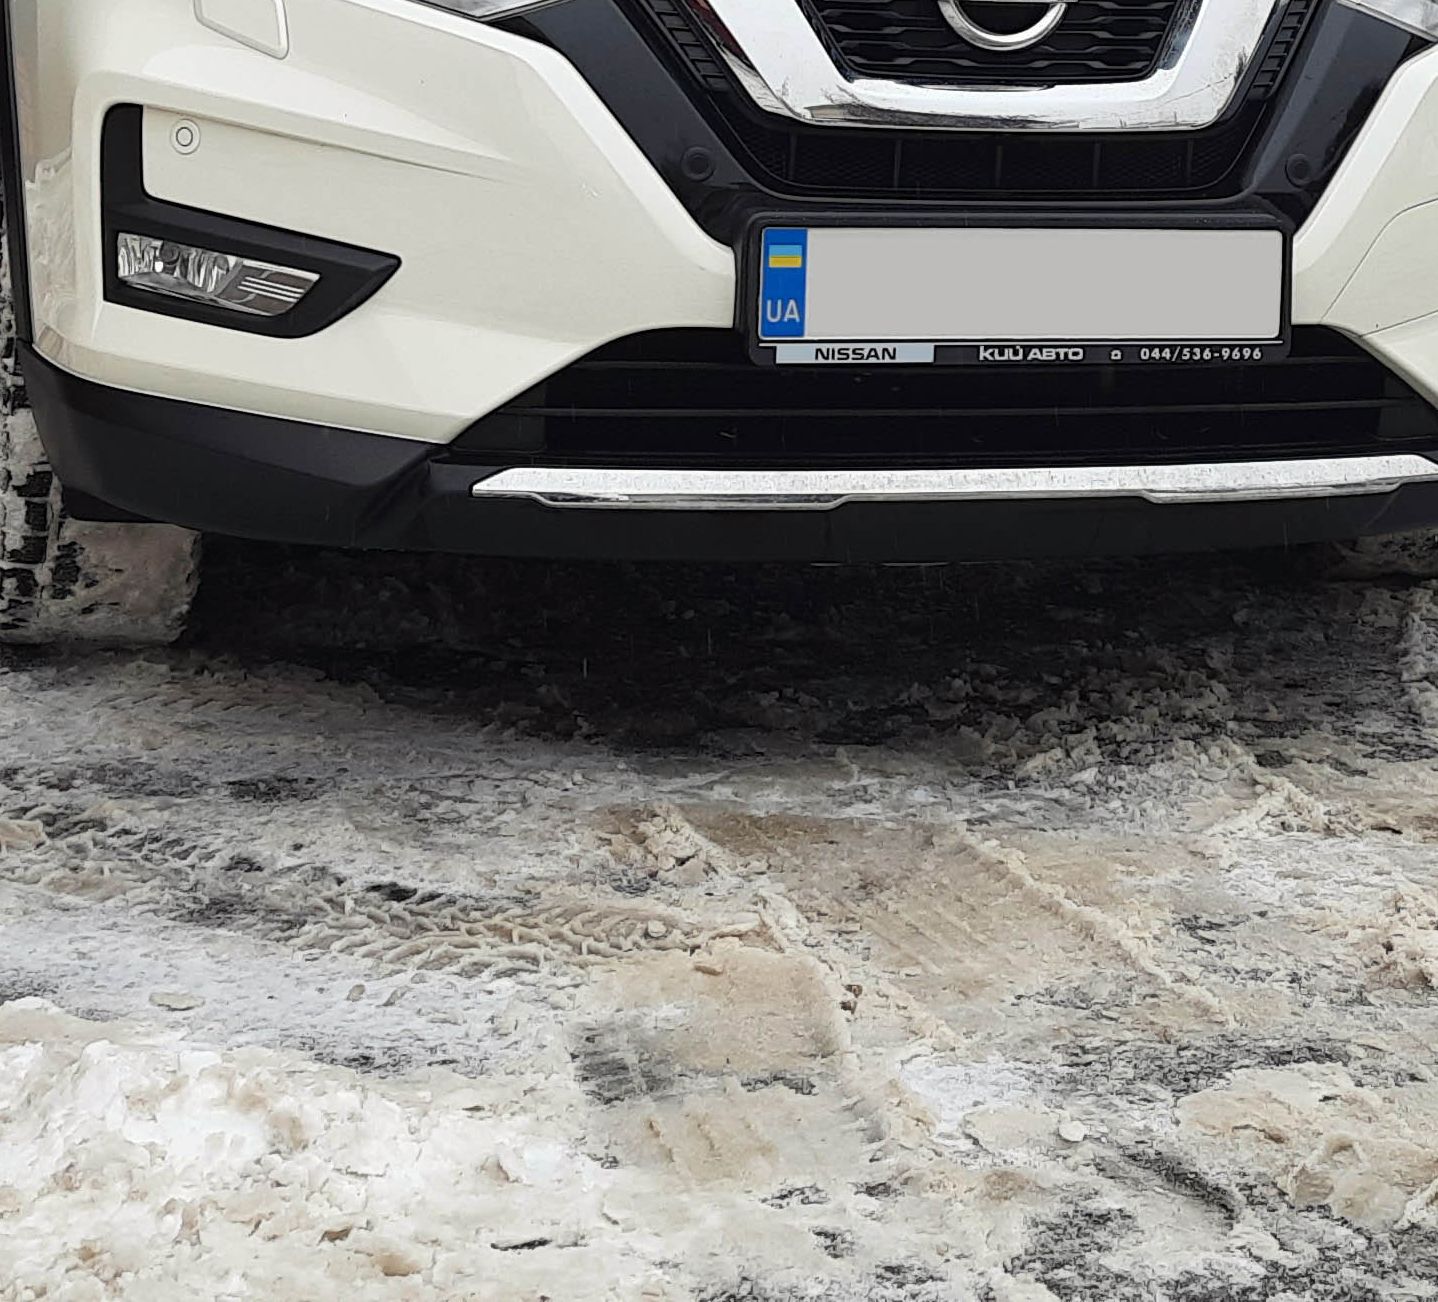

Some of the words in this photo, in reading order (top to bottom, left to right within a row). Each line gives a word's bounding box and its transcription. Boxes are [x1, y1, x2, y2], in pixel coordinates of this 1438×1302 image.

[766, 299, 800, 323] UA
[814, 347, 897, 361] NISSAN
[1140, 347, 1262, 361] 044/536-9696
